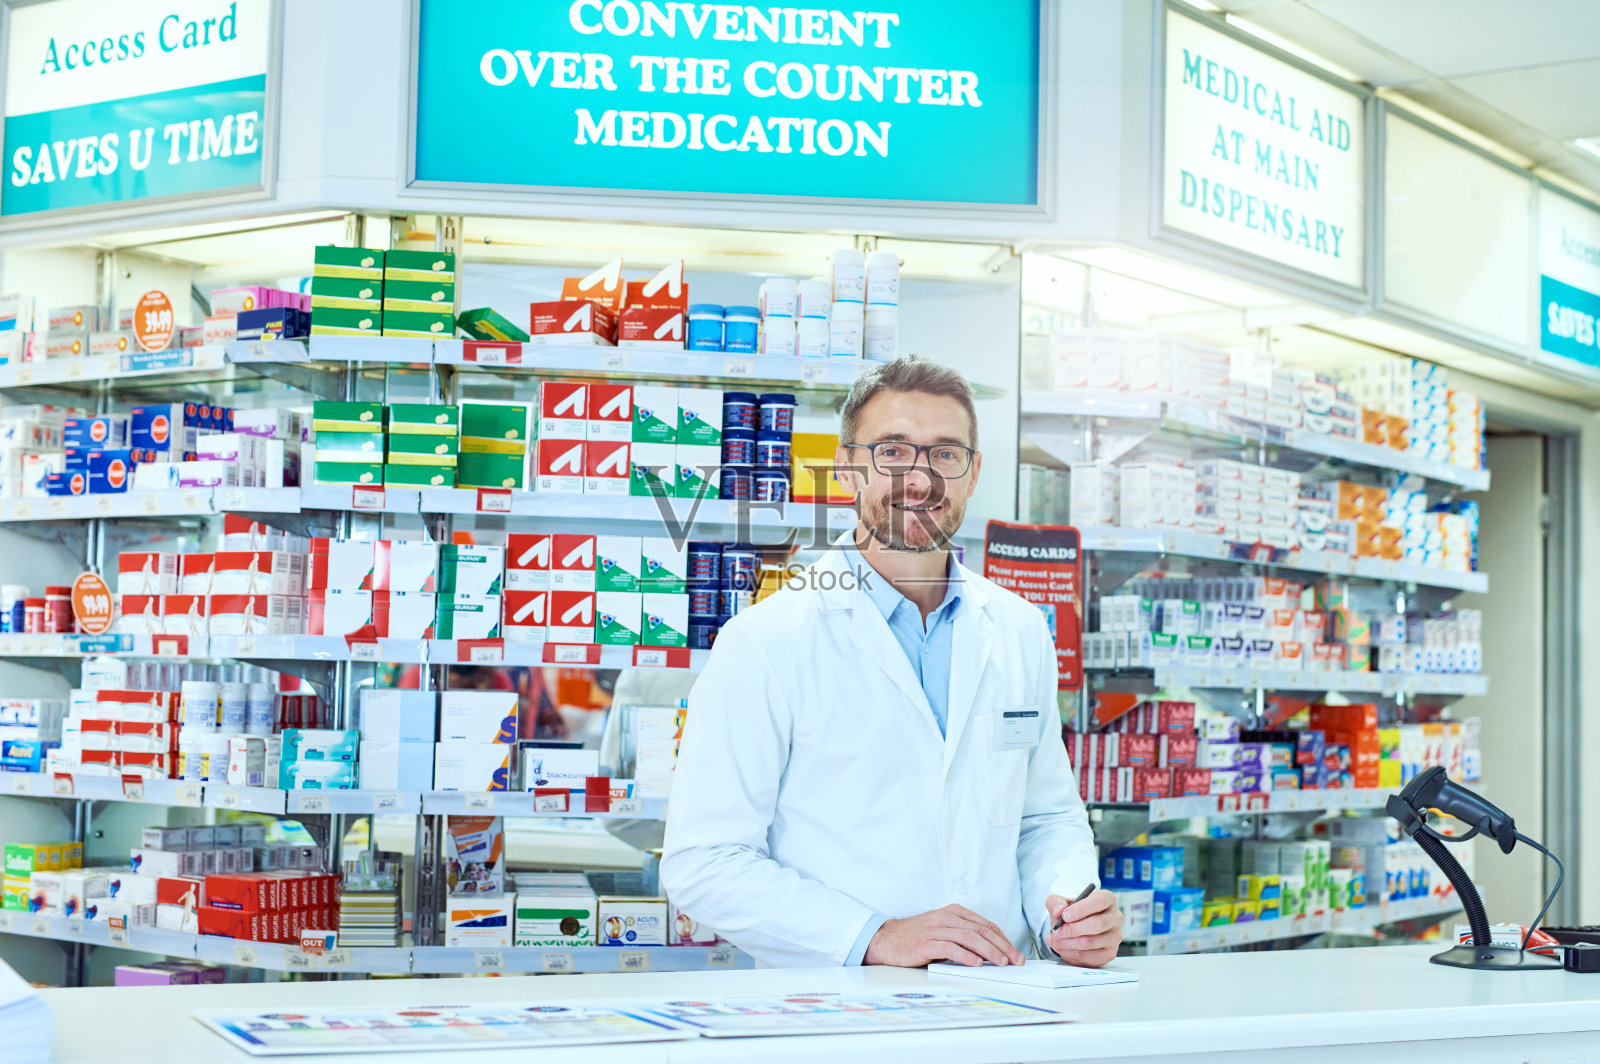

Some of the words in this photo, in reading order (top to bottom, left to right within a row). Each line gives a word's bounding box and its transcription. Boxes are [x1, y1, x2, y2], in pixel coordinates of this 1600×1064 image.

[40, 30, 146, 75] Access
[158, 1, 238, 53] Card
[569, 0, 900, 49] CONVENIENT
[479, 47, 618, 93] OVER
[630, 54, 732, 96] THE
[743, 60, 983, 108] COUNTER
[1182, 48, 1301, 132] MEDICAL
[1309, 107, 1351, 152] AID
[11, 132, 120, 188] SAVES
[128, 127, 155, 171] U
[163, 110, 260, 165] TIME
[573, 108, 893, 158] MEDICATION
[1211, 122, 1246, 166] AT
[1254, 138, 1320, 195] MAIN
[1179, 169, 1345, 259] DISPENSARY
[988, 542, 1029, 559] ACCESS
[1029, 546, 1077, 560] CARDS
[988, 564, 1012, 577] Please
[1013, 568, 1048, 580] present
[1049, 571, 1073, 582] your
[1018, 579, 1048, 590] Access
[1048, 581, 1074, 591] Card
[1023, 591, 1046, 603] YOU
[1047, 593, 1074, 604] TIME
[546, 771, 596, 780] blackcurrant
[303, 939, 324, 947] OUT
